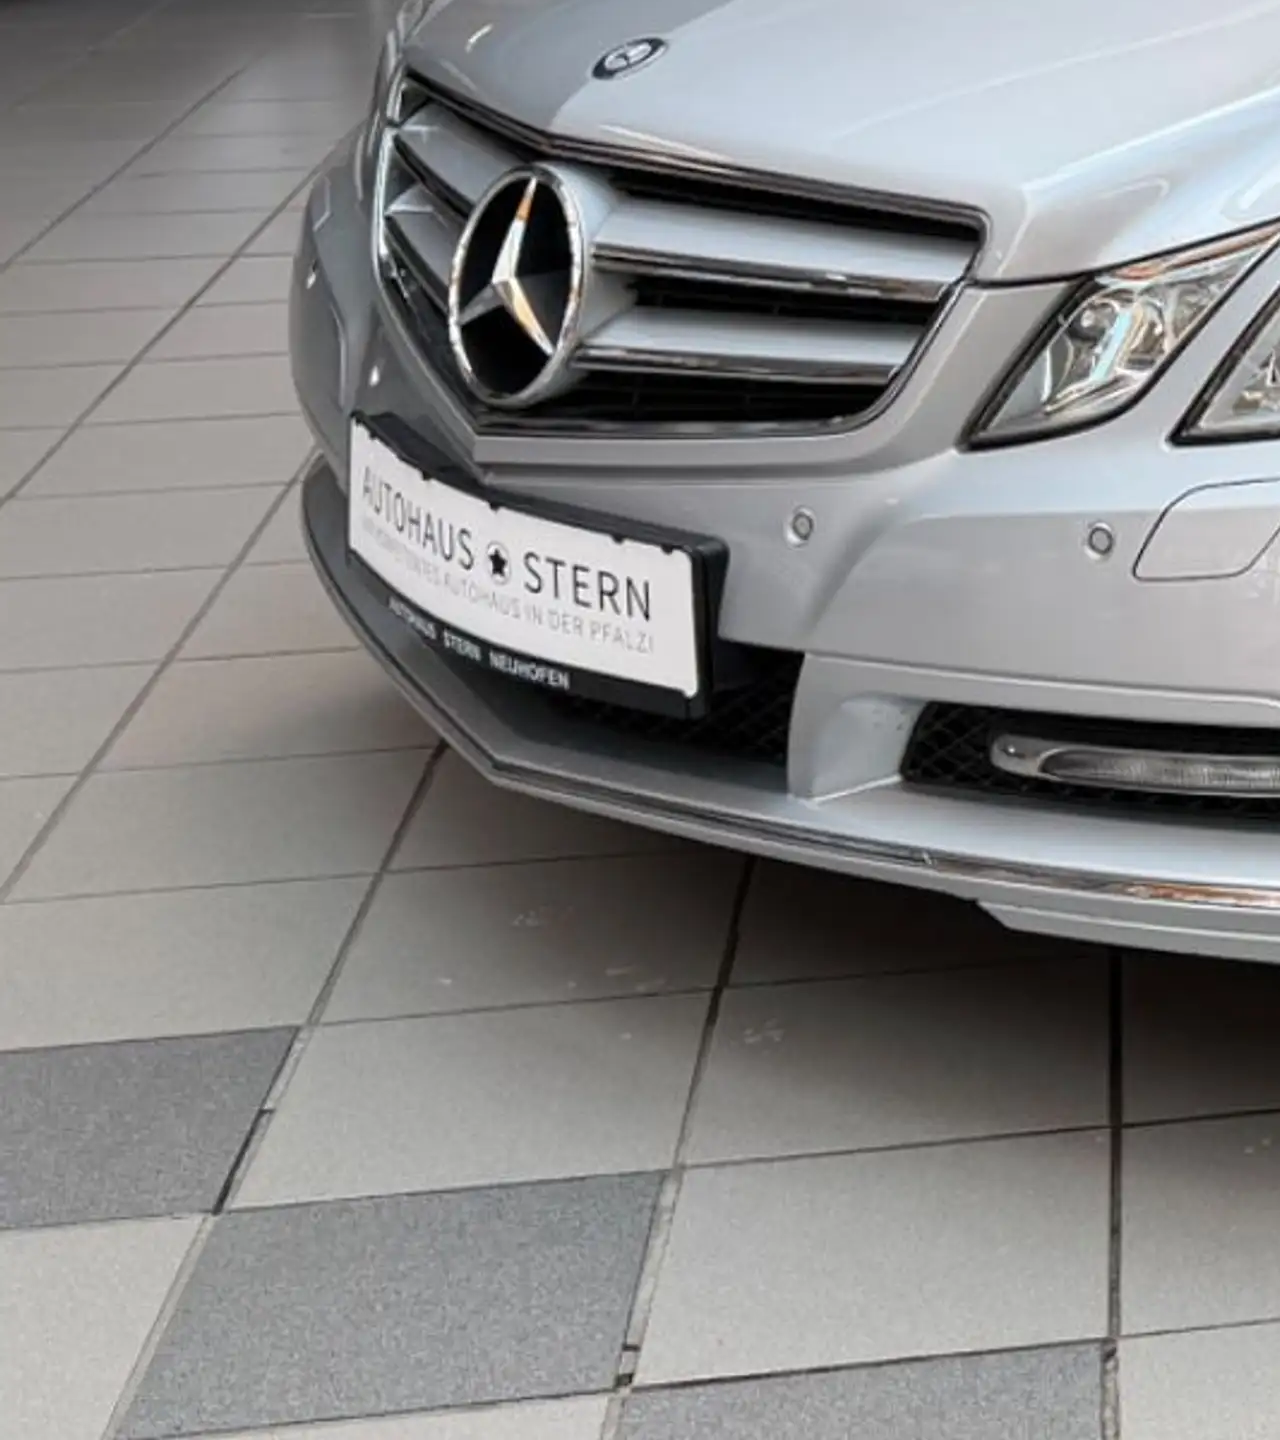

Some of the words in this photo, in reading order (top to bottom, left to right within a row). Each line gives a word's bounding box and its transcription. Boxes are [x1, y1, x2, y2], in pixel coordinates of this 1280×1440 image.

[362, 465, 475, 571] AUTOHAUS
[523, 551, 652, 622] STERN
[526, 602, 543, 625] IN
[548, 608, 583, 637] DER
[443, 628, 482, 662] STERN
[488, 648, 571, 691] NEUHOFEN
